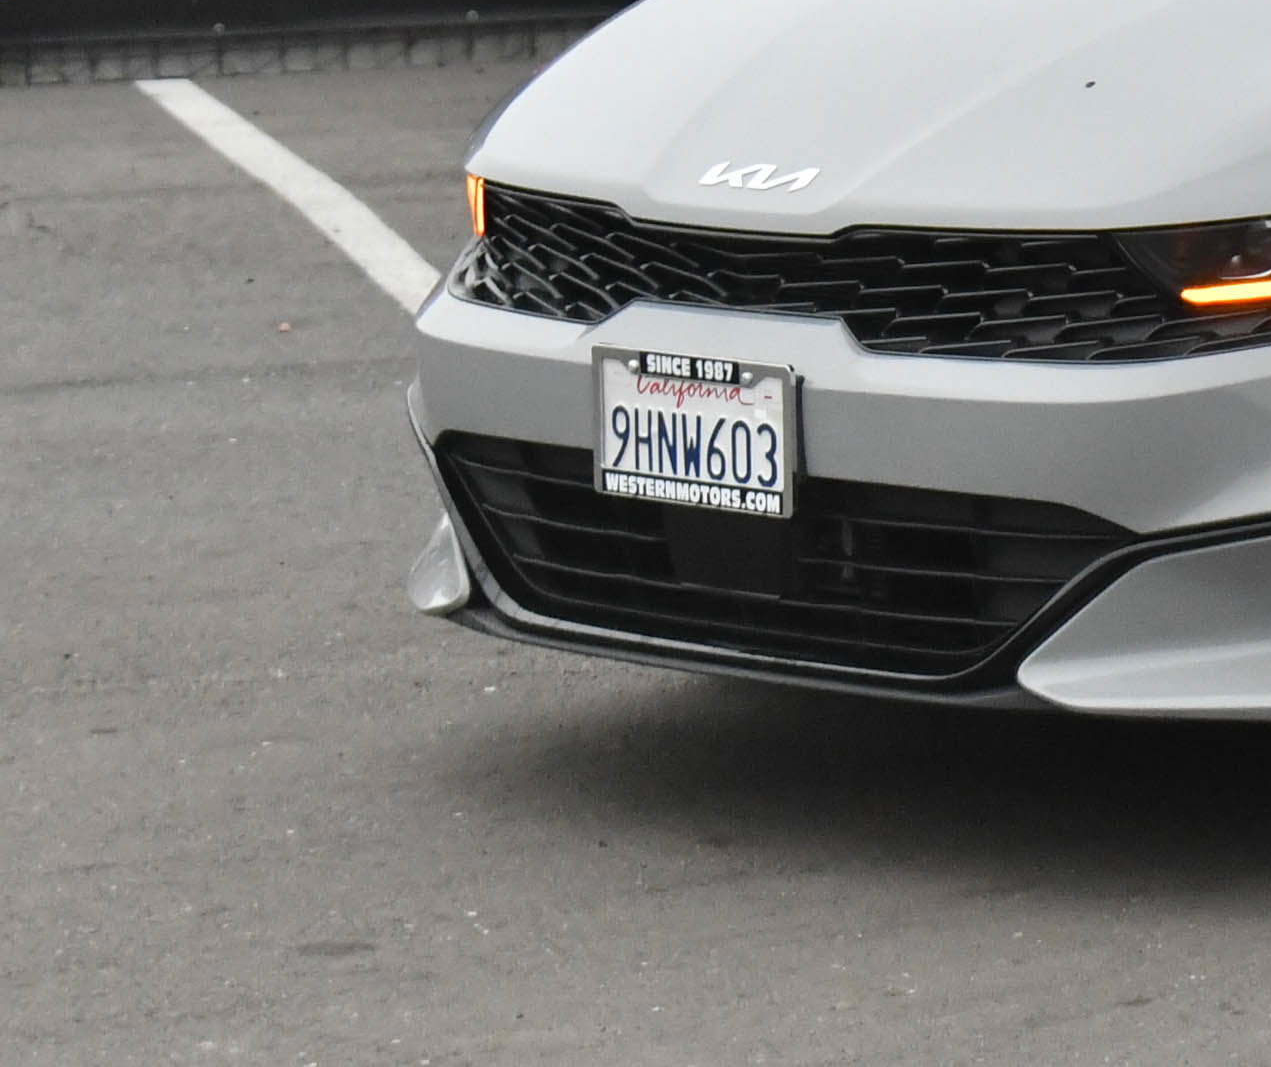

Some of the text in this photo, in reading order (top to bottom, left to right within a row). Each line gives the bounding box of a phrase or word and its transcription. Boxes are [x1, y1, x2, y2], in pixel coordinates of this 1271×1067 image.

[698, 161, 820, 192] KIA
[646, 353, 733, 382] SINCE 1987
[636, 374, 755, 409] California
[612, 405, 778, 488] 9HNW603
[605, 472, 781, 514] WESTERNMOTORS.COM
